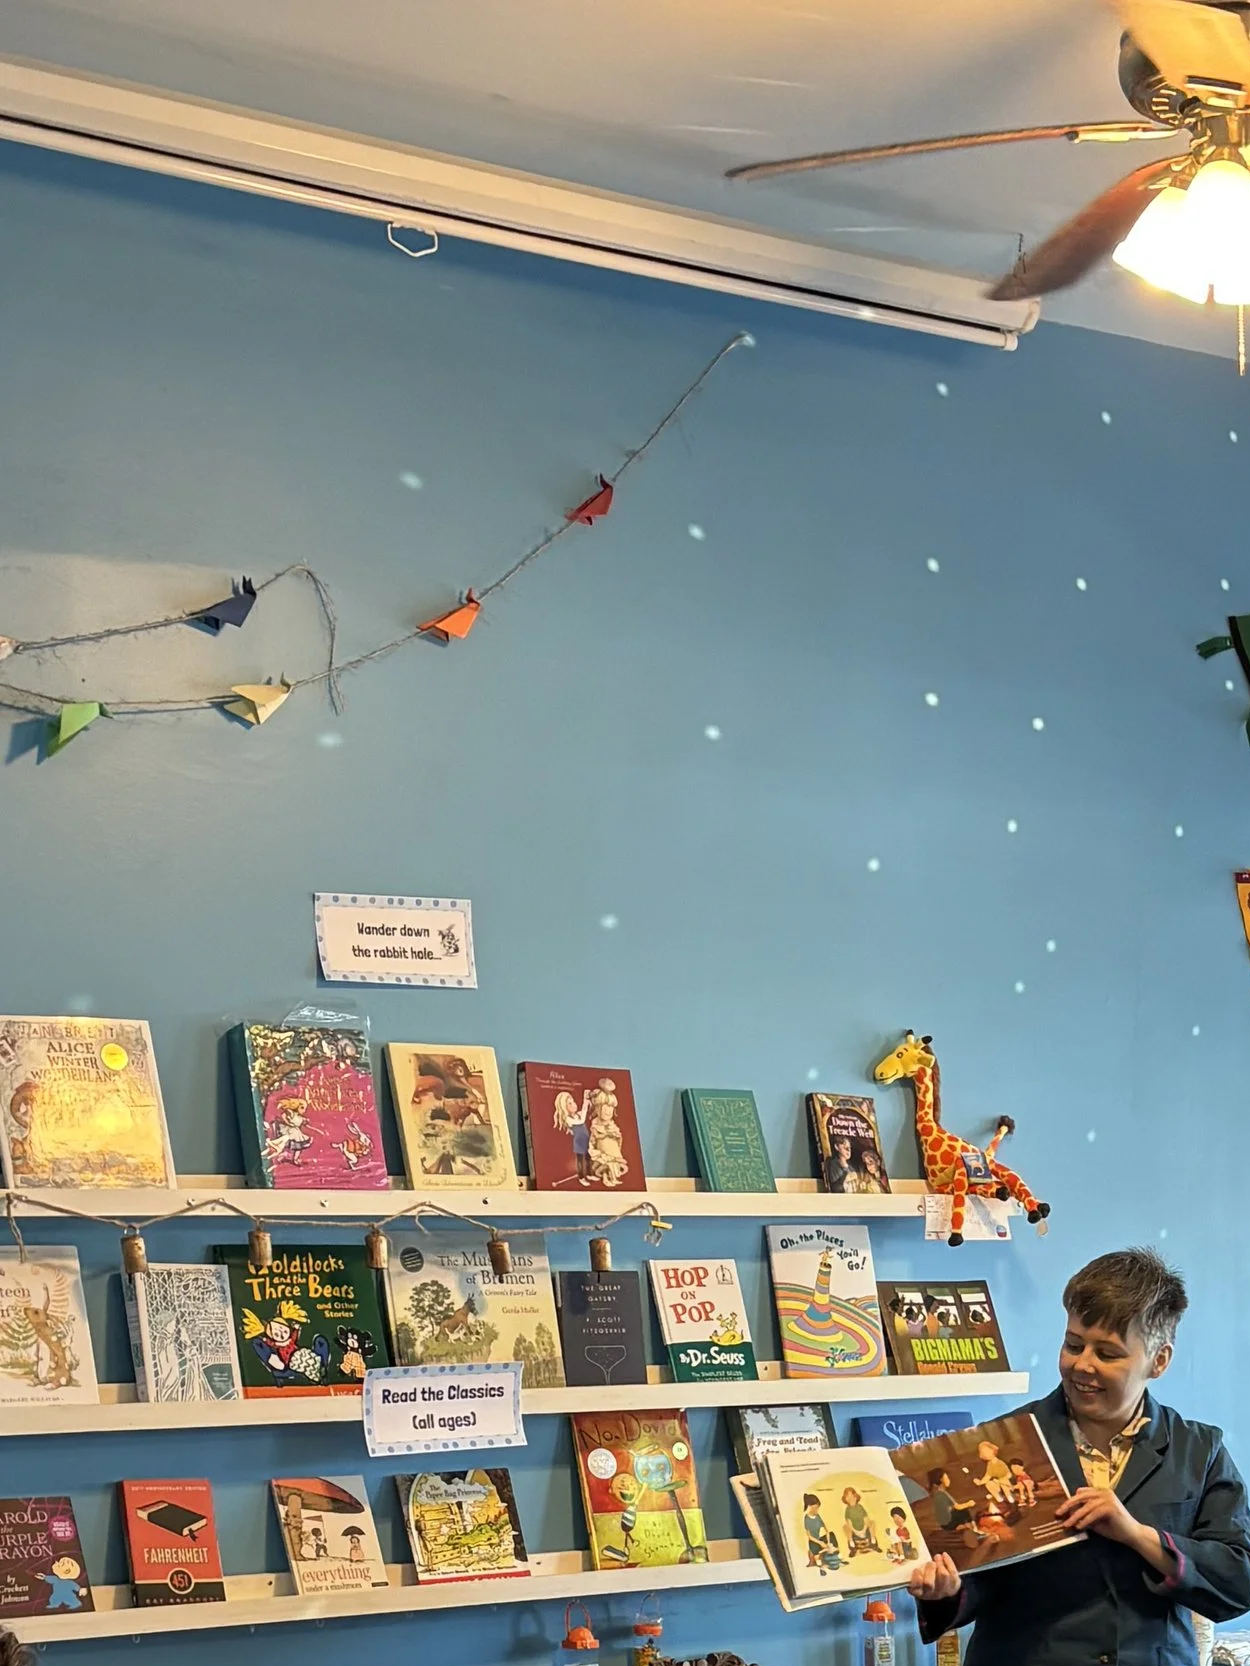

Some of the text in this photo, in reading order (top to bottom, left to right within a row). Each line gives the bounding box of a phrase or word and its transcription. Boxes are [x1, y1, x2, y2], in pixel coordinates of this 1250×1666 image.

[357, 922, 430, 937] Wander down
[352, 945, 371, 958] the
[373, 946, 408, 960] rabbit
[47, 1042, 95, 1055] ALICE
[48, 1055, 100, 1070] WINTER
[831, 1116, 856, 1128] Down
[856, 1119, 868, 1129] the
[829, 1125, 874, 1138] Treacle Well
[800, 1234, 815, 1243] the
[815, 1230, 844, 1248] Places
[437, 1255, 459, 1267] The
[847, 1257, 866, 1271] Go!
[273, 1274, 306, 1284] and the
[466, 1270, 535, 1285] of Brmen
[661, 1266, 709, 1289] HOP
[245, 1273, 355, 1301] Three Bears
[509, 1290, 524, 1298] Fairy
[681, 1291, 696, 1300] ON
[334, 1302, 358, 1310] Other
[670, 1301, 715, 1324] POP
[324, 1310, 354, 1318] Stories
[911, 1336, 999, 1361] BIGMAMA'S
[679, 1346, 745, 1367] By Dr. Seuss
[382, 1383, 505, 1404] Read the Classics
[412, 1411, 477, 1431] (all ages)
[755, 1436, 819, 1447] Frog and Toad
[444, 1490, 457, 1498] Bag
[143, 1547, 208, 1564] FAHRENHEIT
[7, 1575, 15, 1585] by
[172, 1573, 189, 1588] 451
[302, 1564, 373, 1583] everything
[305, 1585, 324, 1593] under
